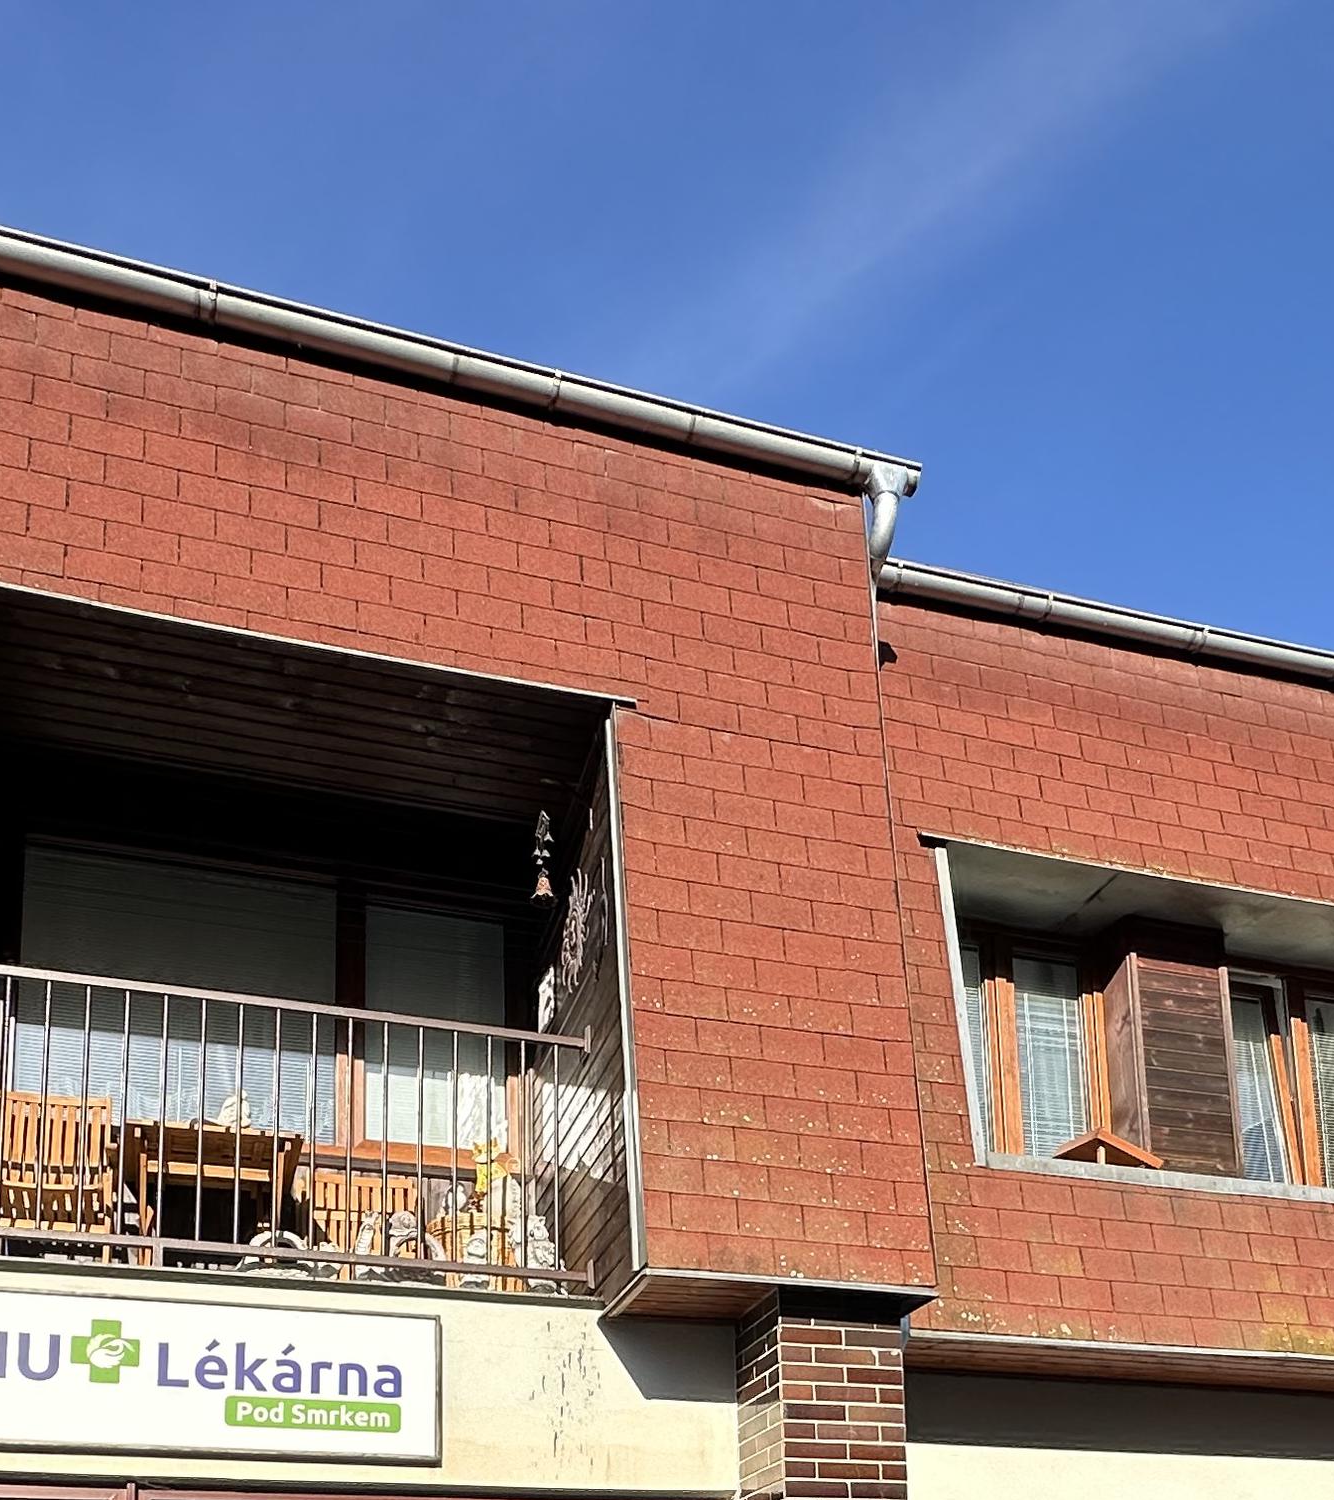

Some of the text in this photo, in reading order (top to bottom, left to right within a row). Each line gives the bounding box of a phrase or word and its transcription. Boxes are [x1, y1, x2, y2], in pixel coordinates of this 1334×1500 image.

[157, 1339, 402, 1398] Lékárna
[235, 1401, 391, 1428] Pod Smrkem
